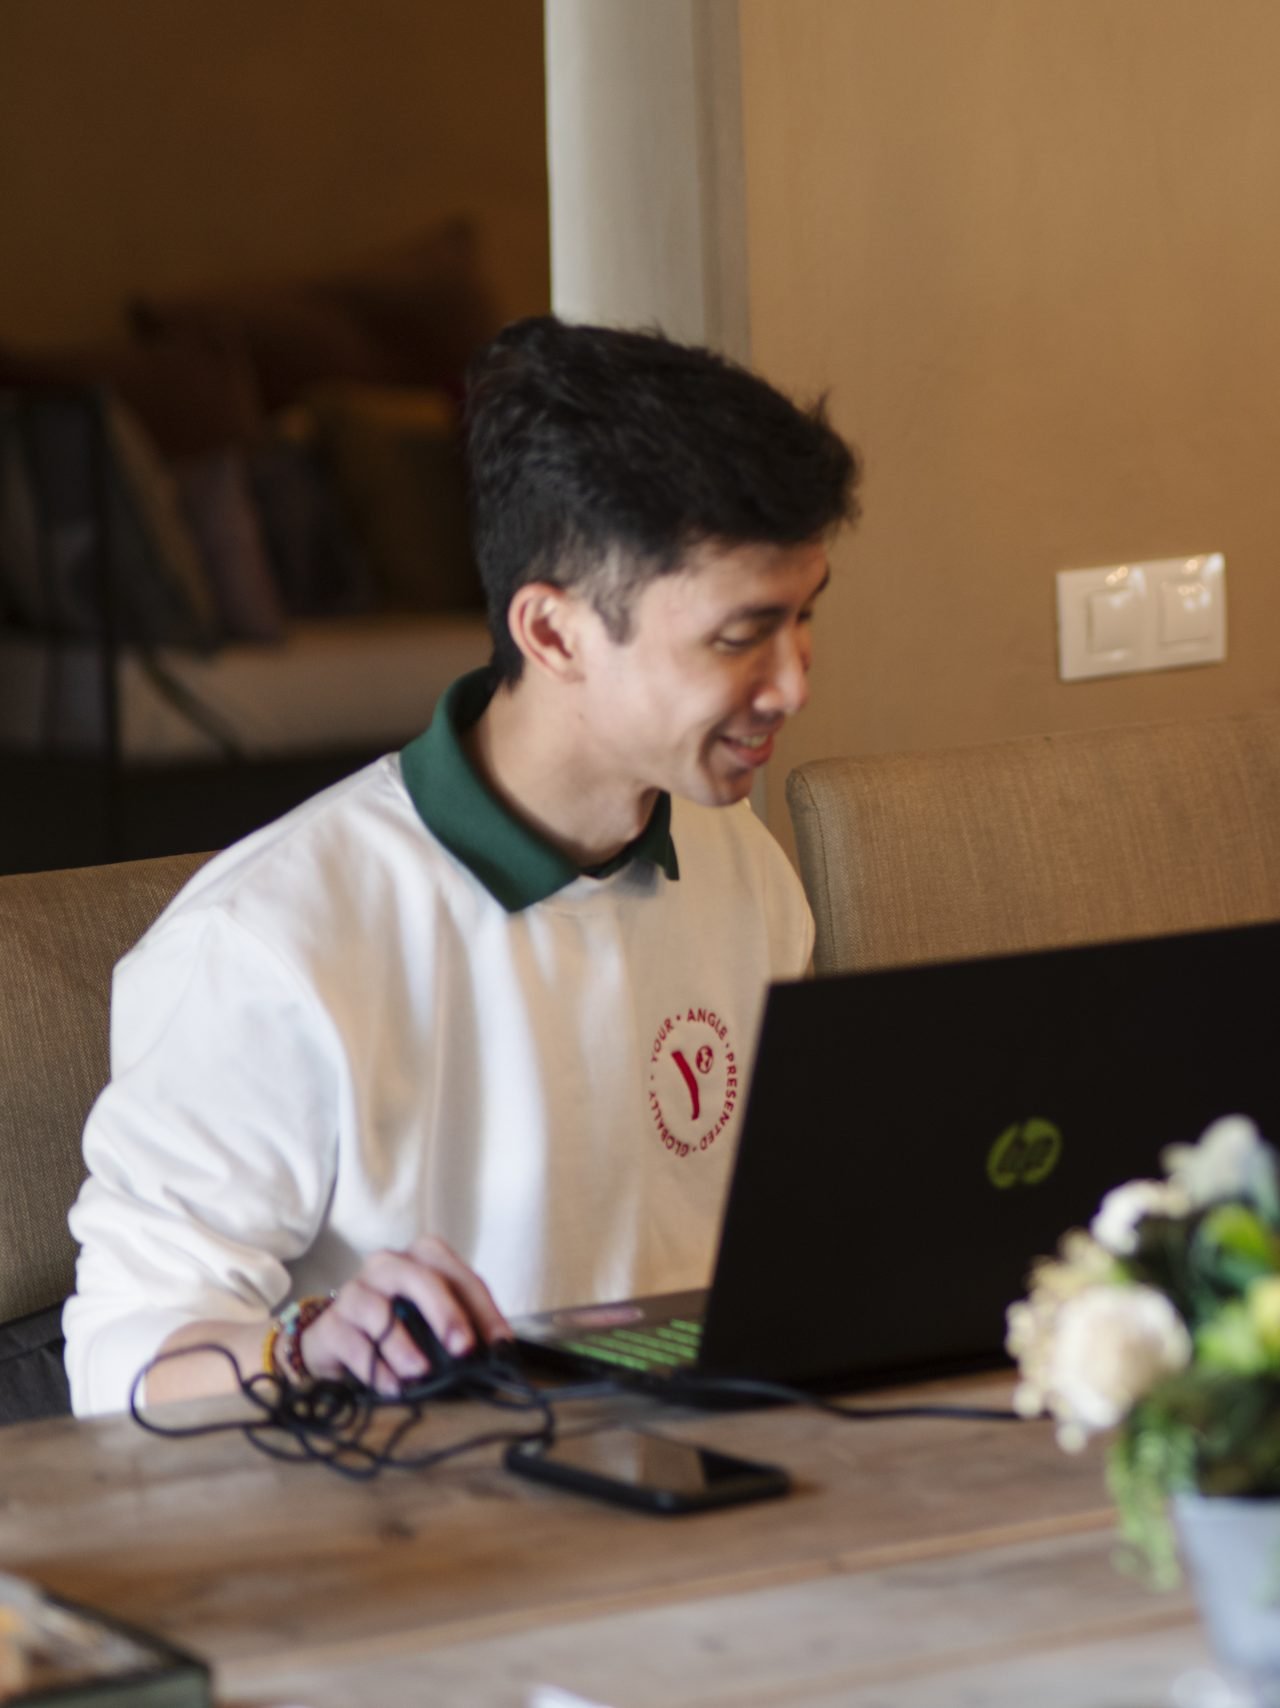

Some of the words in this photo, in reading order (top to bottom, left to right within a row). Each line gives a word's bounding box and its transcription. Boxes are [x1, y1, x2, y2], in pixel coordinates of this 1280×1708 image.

[652, 1018, 674, 1062] YOUR
[687, 1008, 728, 1040] ANGLE
[649, 1090, 689, 1158] GLOBALLY
[700, 1052, 738, 1150] PRESENTED
